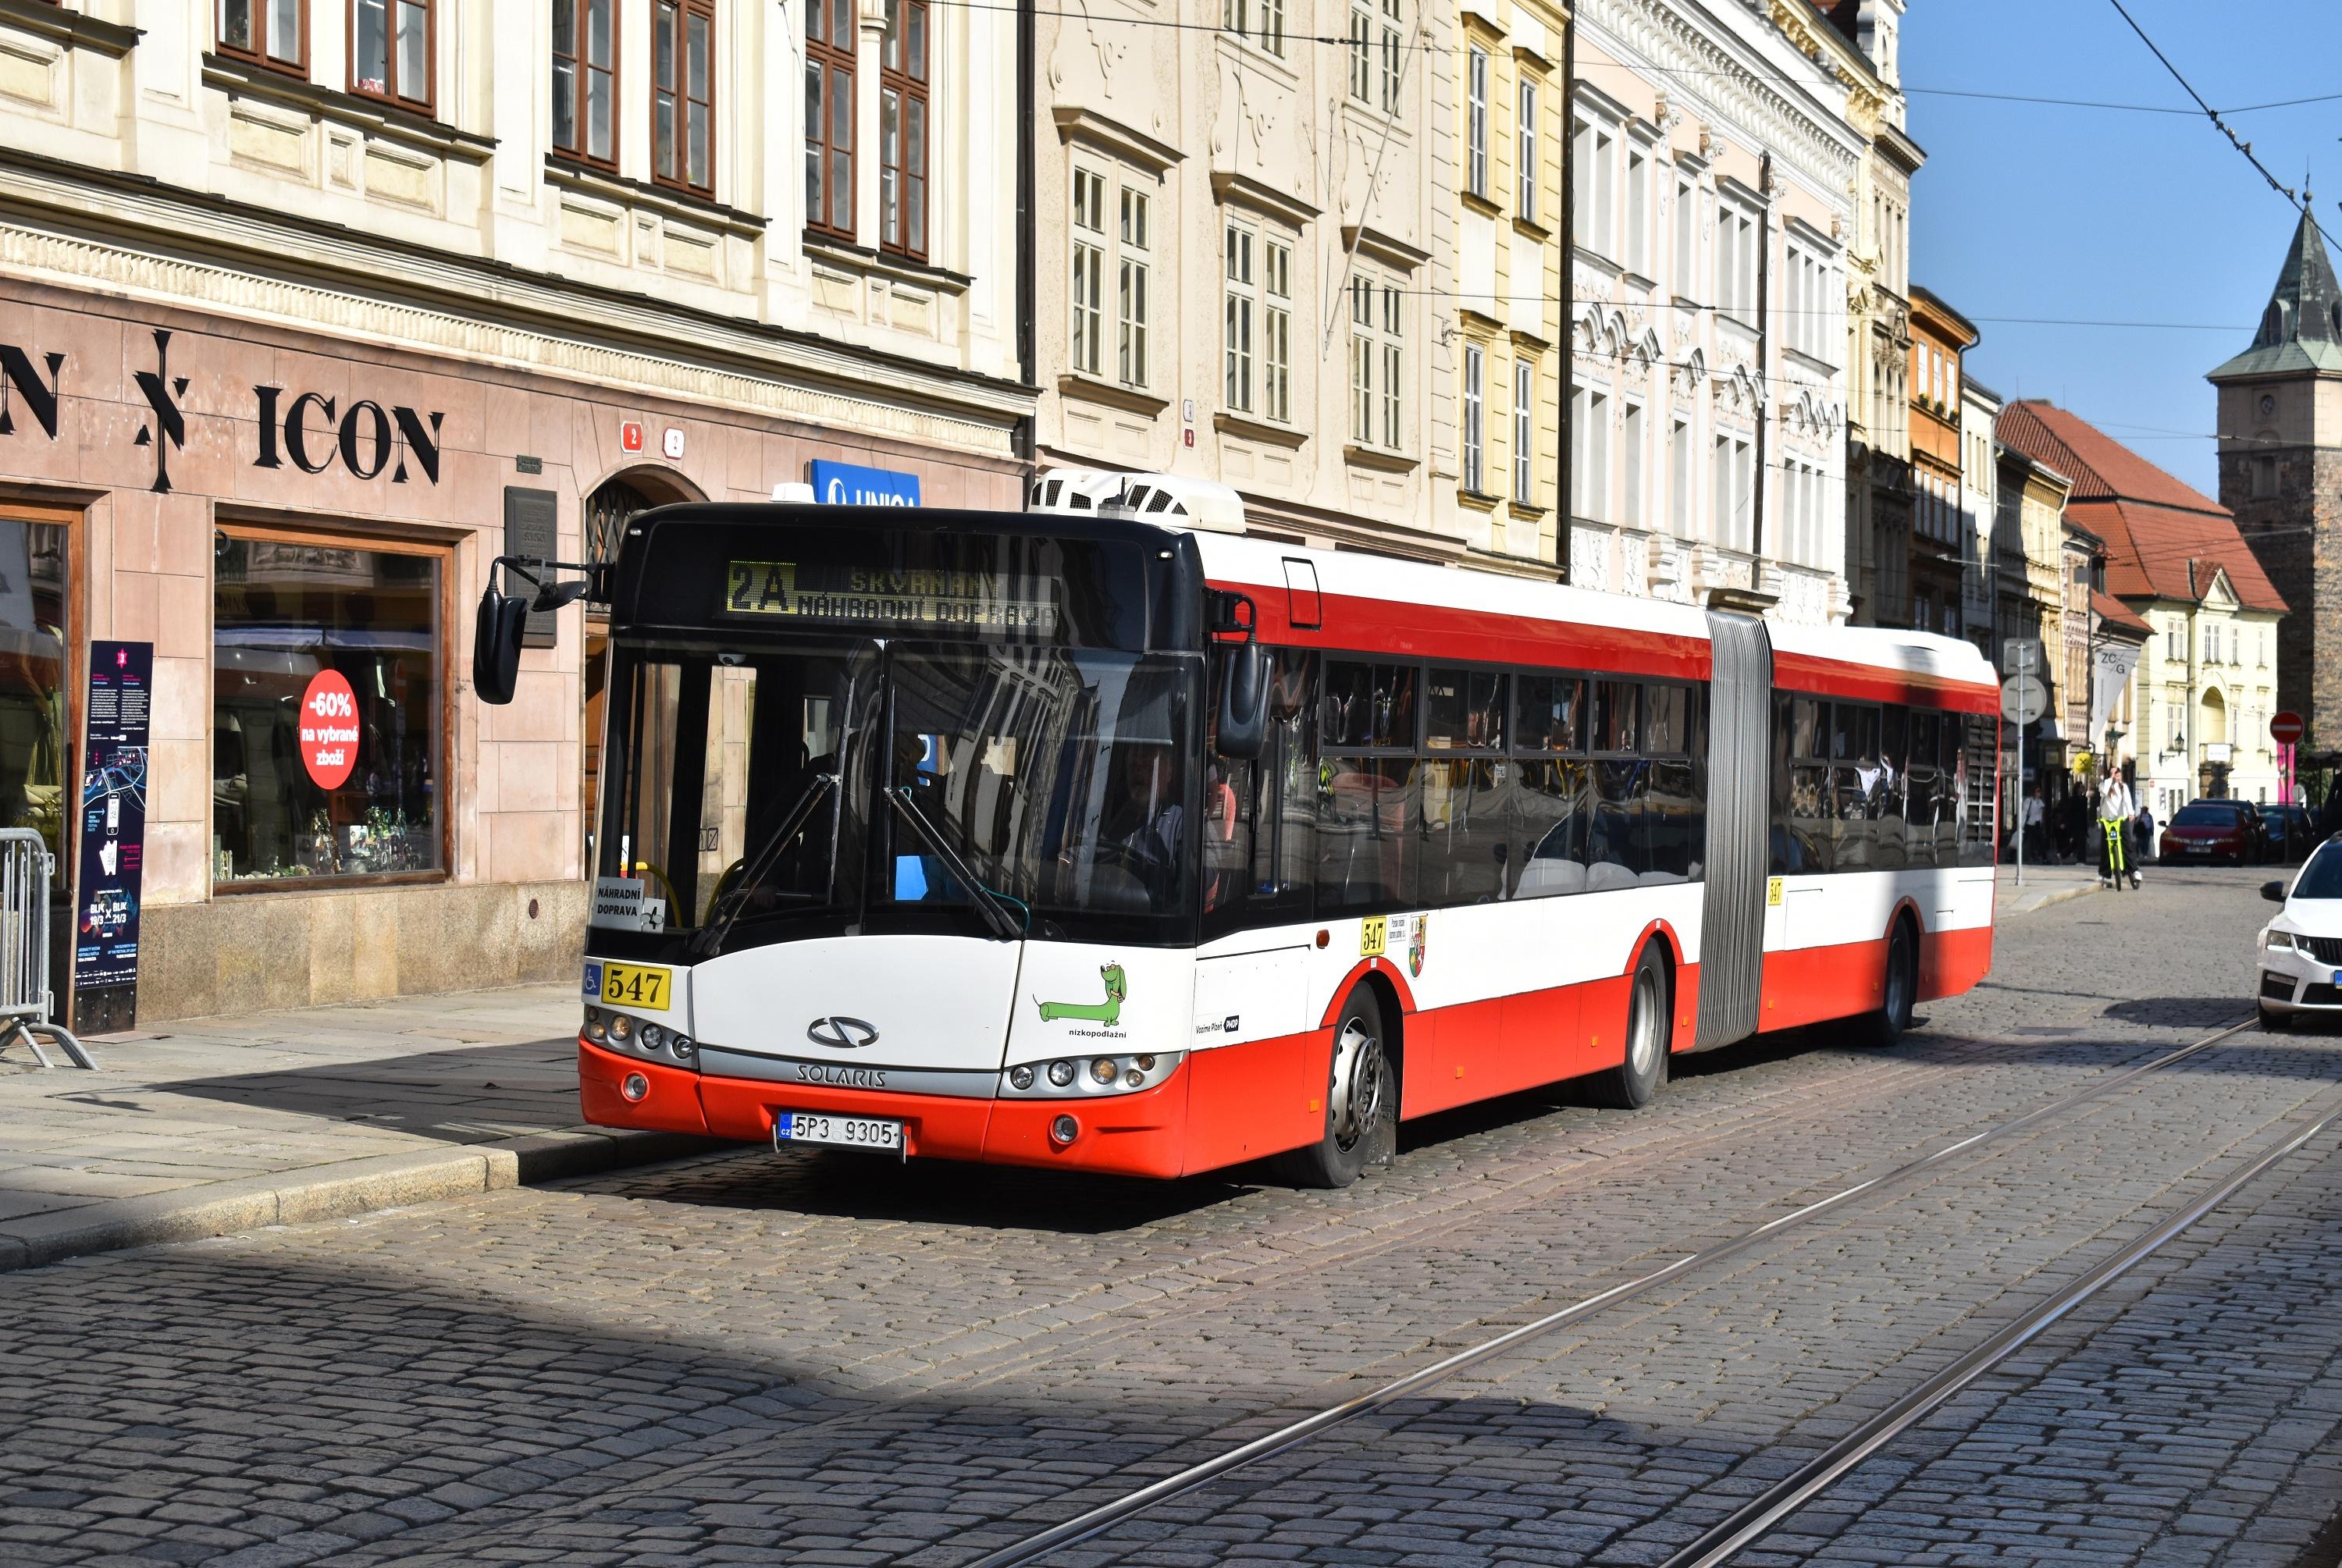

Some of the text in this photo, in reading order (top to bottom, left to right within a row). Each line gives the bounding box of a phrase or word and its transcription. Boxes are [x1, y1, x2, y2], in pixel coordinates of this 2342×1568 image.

[254, 385, 446, 486] ICON
[631, 428, 638, 445] 2
[732, 565, 788, 611] 2A
[798, 593, 924, 619] NÁHRADNÍ
[308, 692, 352, 717] -60%
[301, 725, 358, 745] na vybrané
[316, 749, 345, 766] zboží
[597, 886, 641, 900] NÁHRADNÍ
[90, 915, 104, 926] 19/3
[112, 913, 126, 924] 21/3
[597, 904, 637, 916] DOPRAVA
[1363, 922, 1383, 951] 547
[608, 969, 663, 1003] 547
[1226, 1018, 1239, 1029] PMDP
[795, 1065, 886, 1087] SOLARIS
[795, 1116, 892, 1144] 5P3 9305
